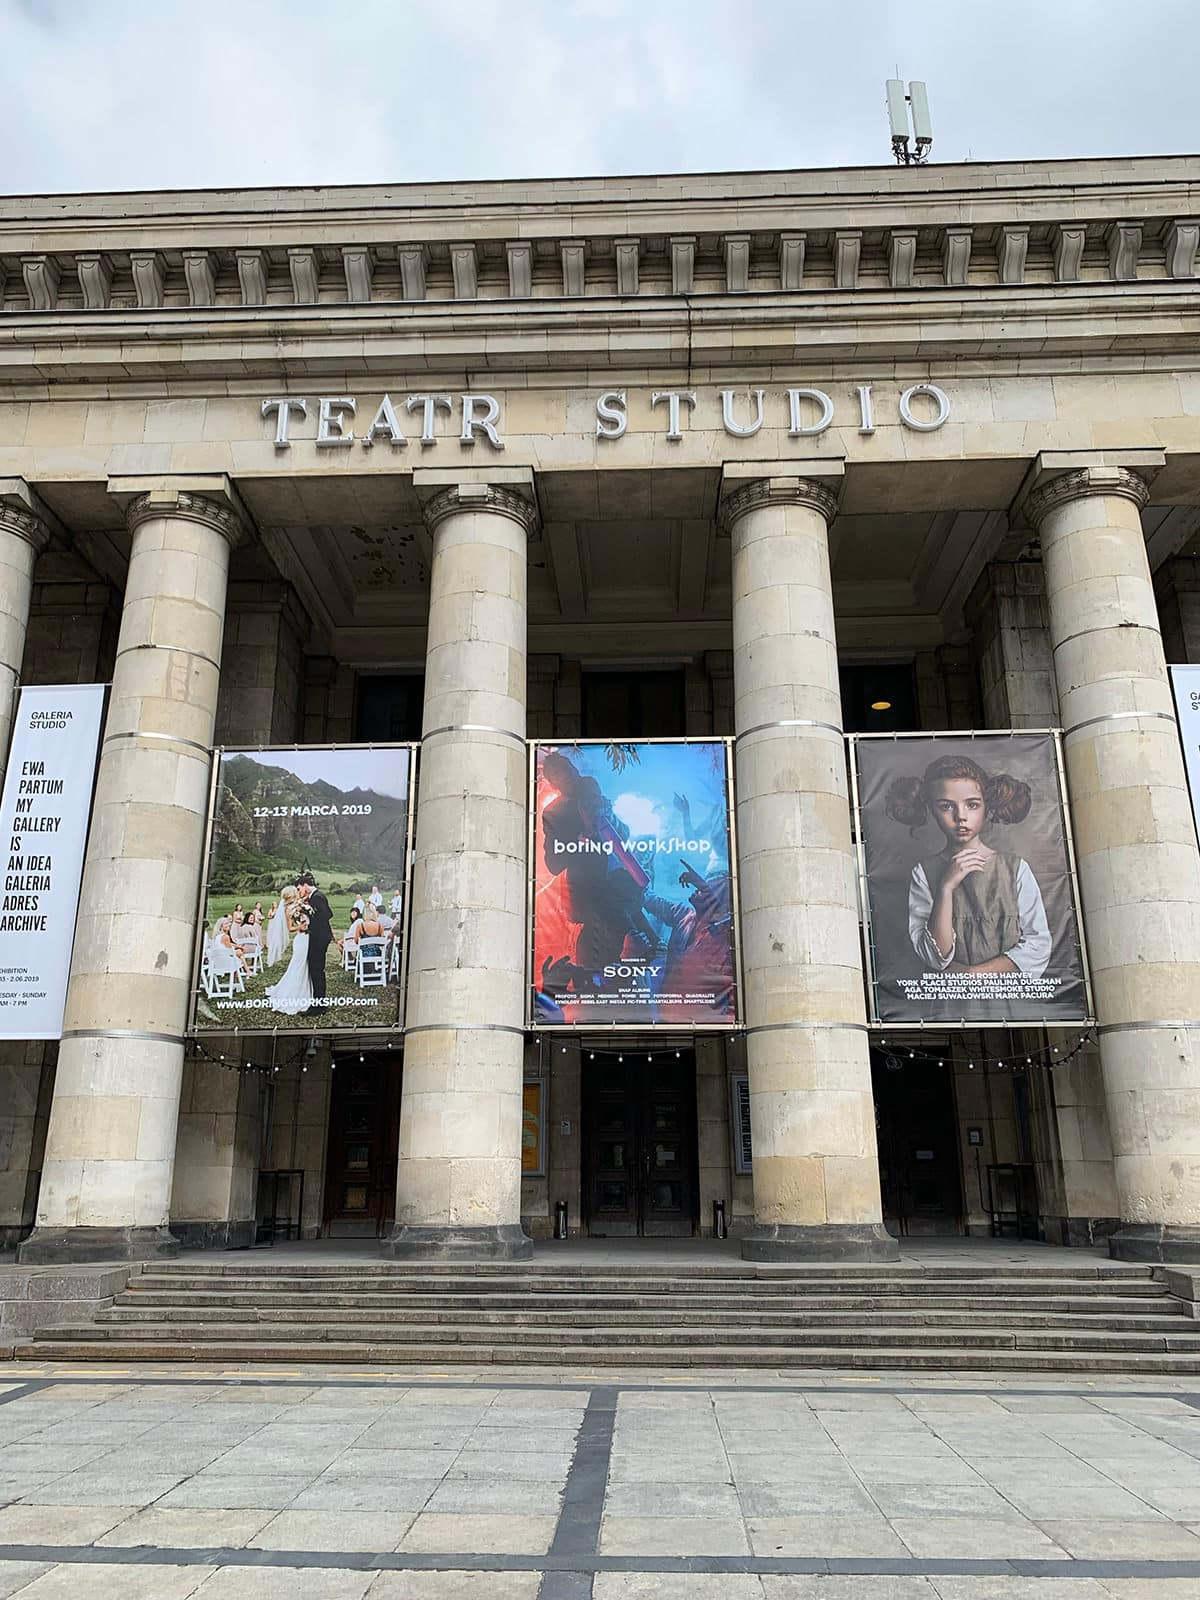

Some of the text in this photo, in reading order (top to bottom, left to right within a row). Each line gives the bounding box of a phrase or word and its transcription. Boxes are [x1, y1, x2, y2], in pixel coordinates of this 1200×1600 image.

[261, 383, 951, 450] TEATR STUDIO
[31, 711, 73, 720] GALERIA
[29, 720, 67, 729] STUDIO
[21, 761, 45, 776] EWA
[18, 779, 64, 795] PARTUM
[15, 798, 34, 813] MY
[253, 804, 372, 818] 12-13 MARCA 2019
[13, 817, 61, 832] GALLERY
[10, 836, 21, 851] IS
[7, 856, 52, 871] AN IDEA
[5, 875, 51, 891] GALERIA
[2, 895, 39, 911] ADRES
[0, 915, 48, 931] ARCHIVE
[603, 966, 662, 978] SONY
[922, 972, 944, 980] BENJ
[945, 972, 975, 980] HAISCH
[1000, 971, 1033, 979] HARVEY
[896, 979, 919, 987] YORK
[920, 979, 947, 987] PLACE
[947, 979, 983, 987] STUDIOS
[984, 978, 1019, 986] PAULINA
[1020, 991, 1054, 999] PACURA
[216, 997, 378, 1009] www.BORINGWORKSHOP.com
